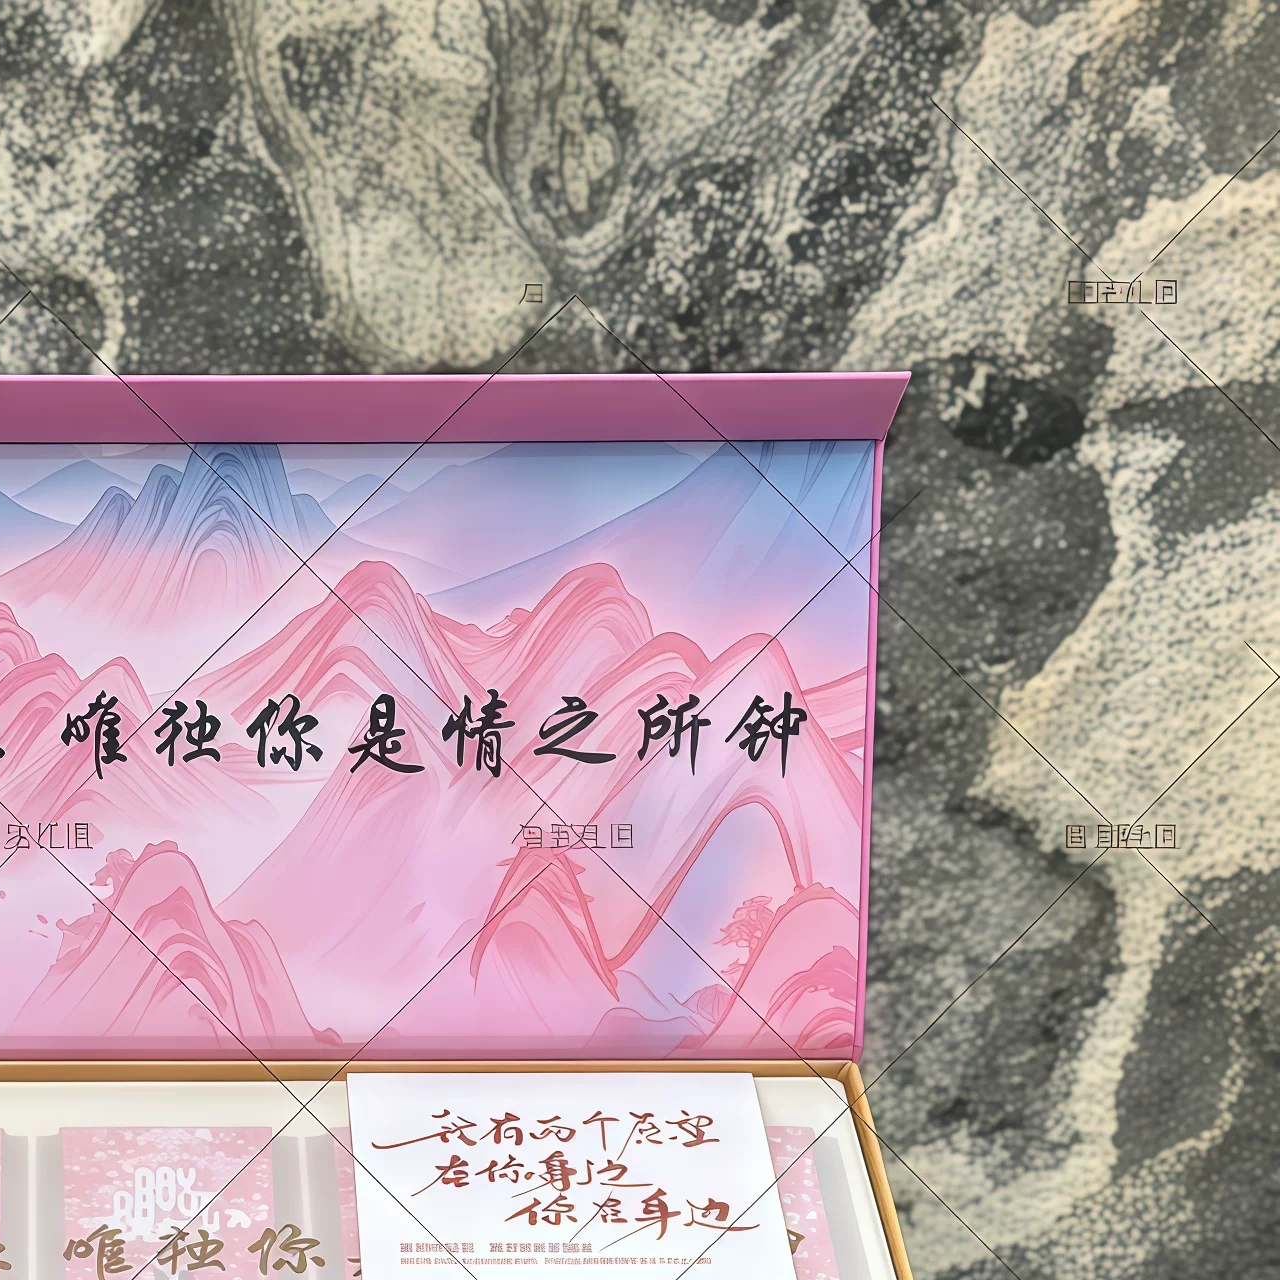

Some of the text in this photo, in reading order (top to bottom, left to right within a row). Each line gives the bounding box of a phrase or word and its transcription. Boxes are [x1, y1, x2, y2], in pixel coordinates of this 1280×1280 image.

[60, 689, 808, 780] 唯独你是情之所钟
[410, 1151, 654, 1198] 在你身边
[504, 1187, 761, 1252] 你在身边
